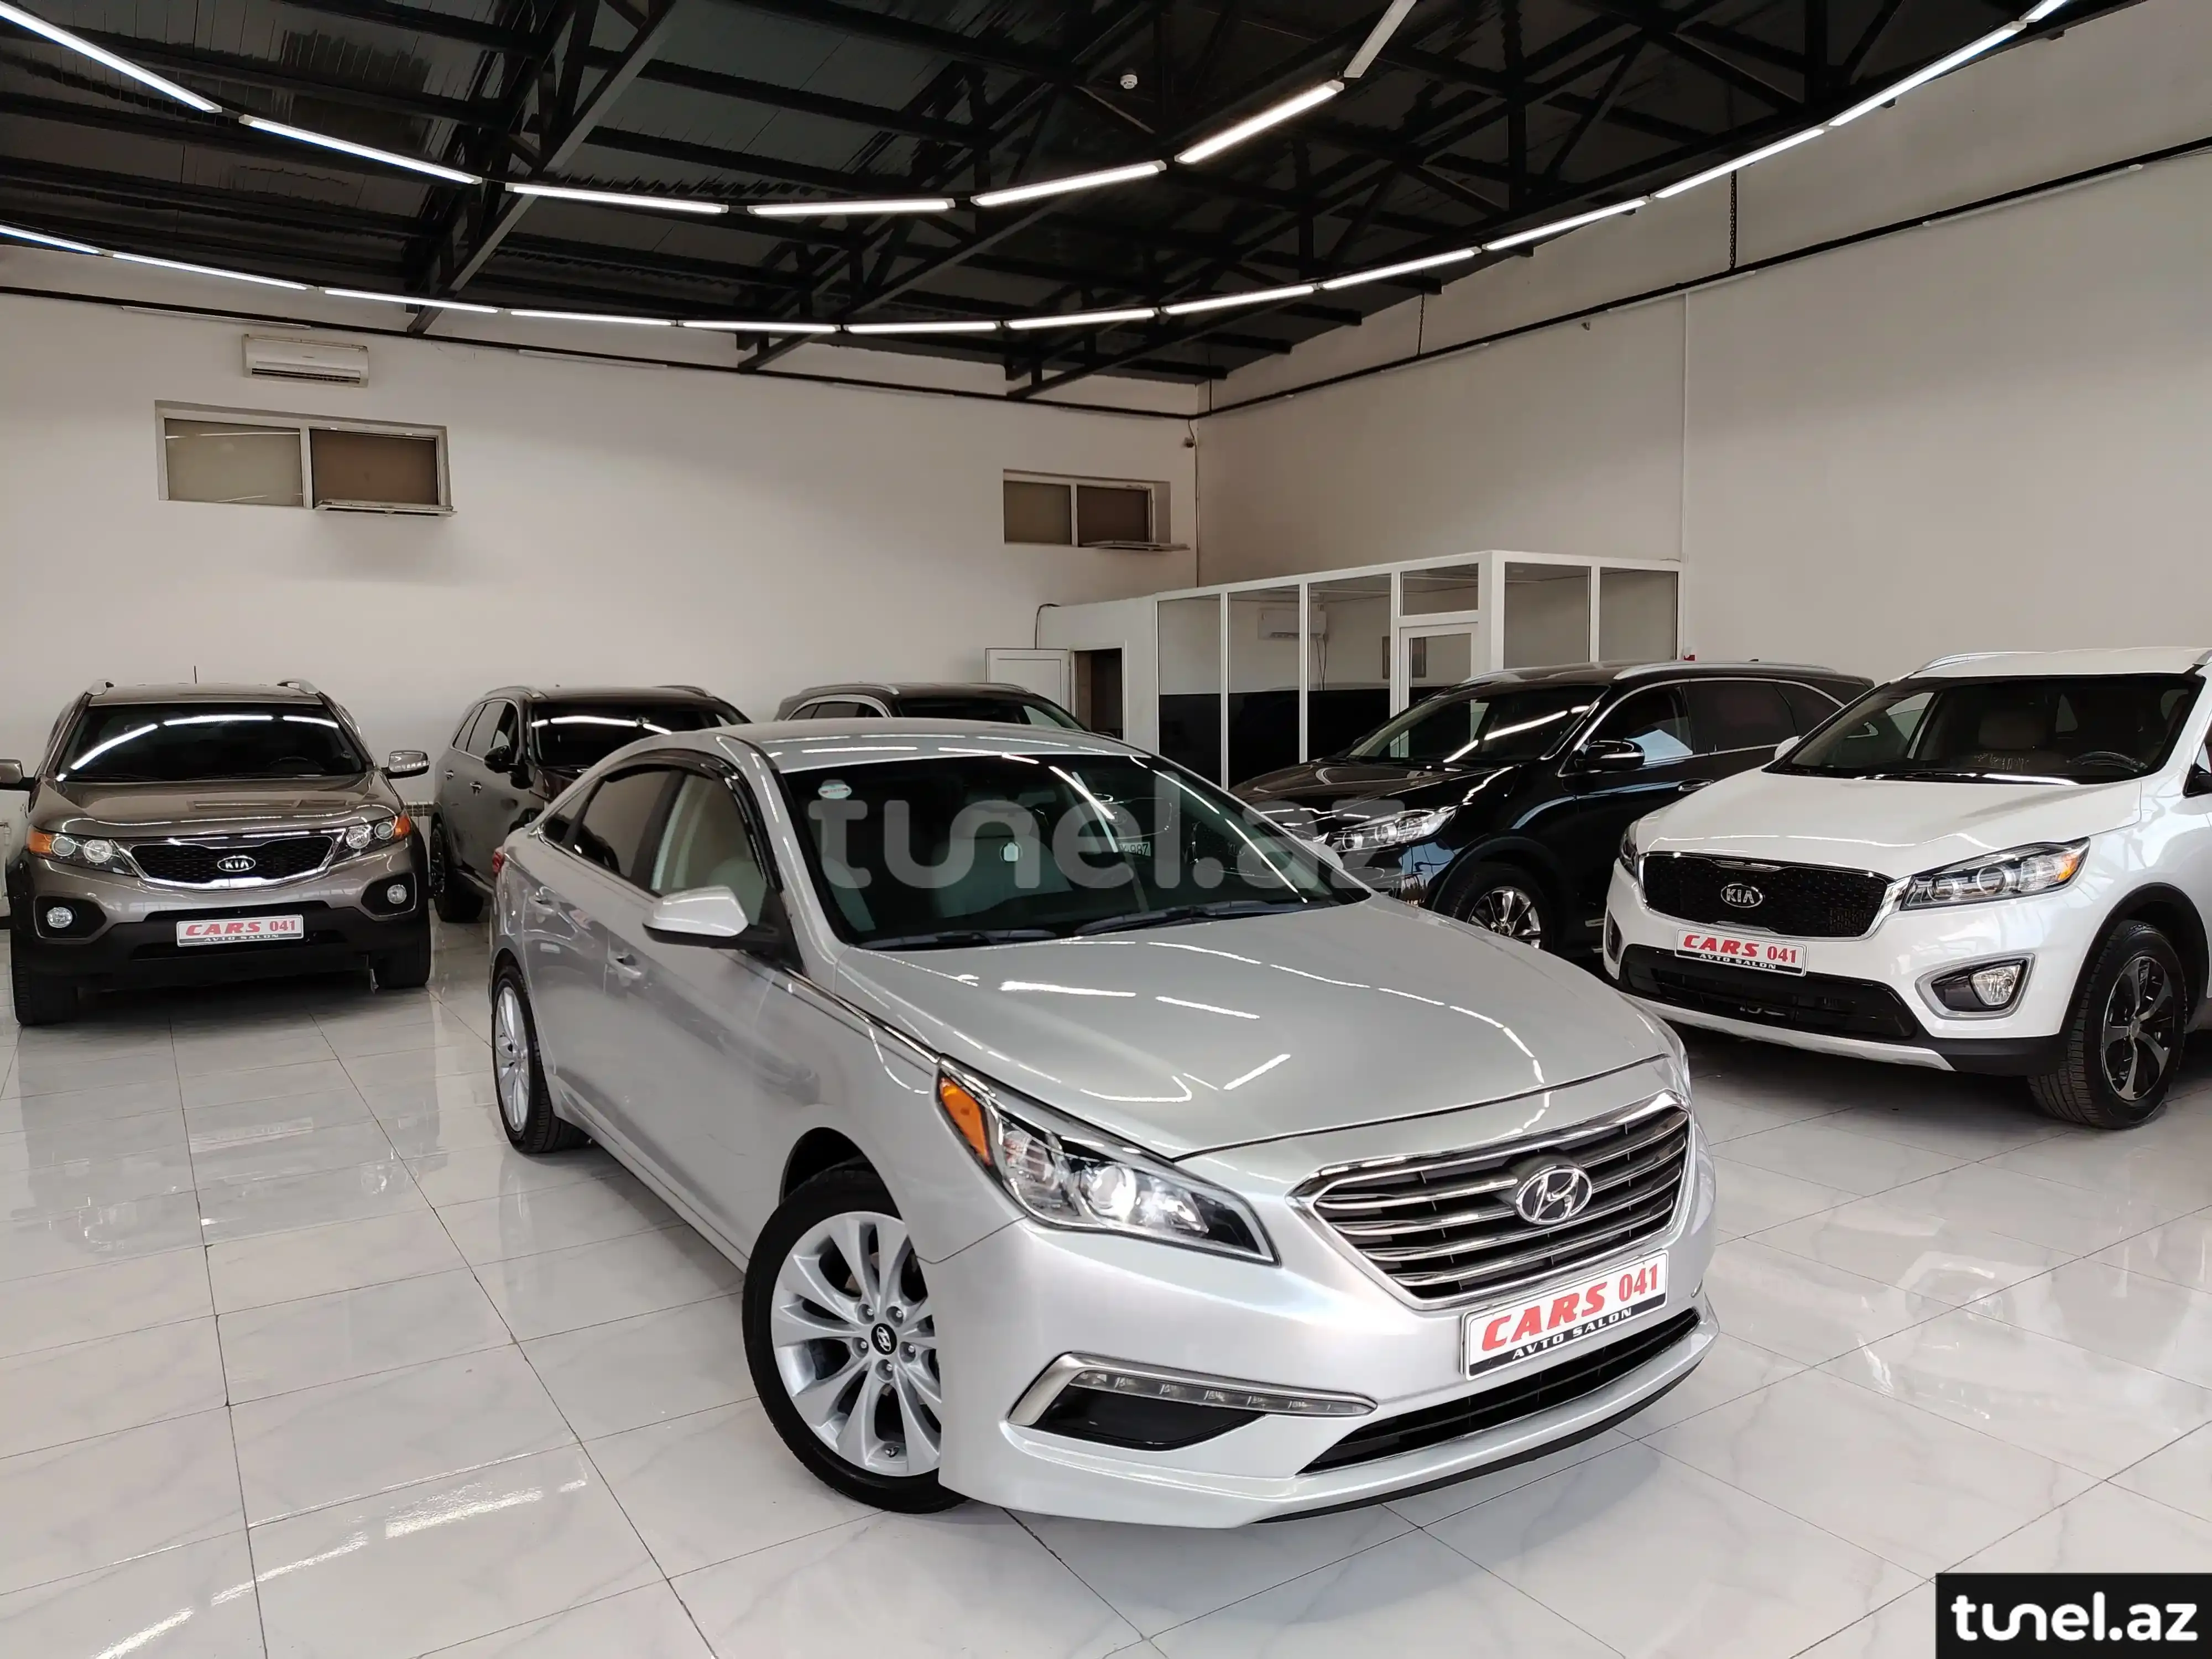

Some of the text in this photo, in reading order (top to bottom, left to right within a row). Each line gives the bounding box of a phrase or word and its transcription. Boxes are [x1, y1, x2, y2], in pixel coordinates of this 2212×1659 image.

[225, 859, 249, 869] KIA
[1726, 888, 1754, 904] KIA
[186, 920, 295, 936] CARS 041
[1683, 935, 1797, 963] CARS 041
[1699, 953, 1776, 969] AVTO SALON
[1481, 1263, 1658, 1352] CARS 041
[1512, 1307, 1632, 1360] AVTO SALON
